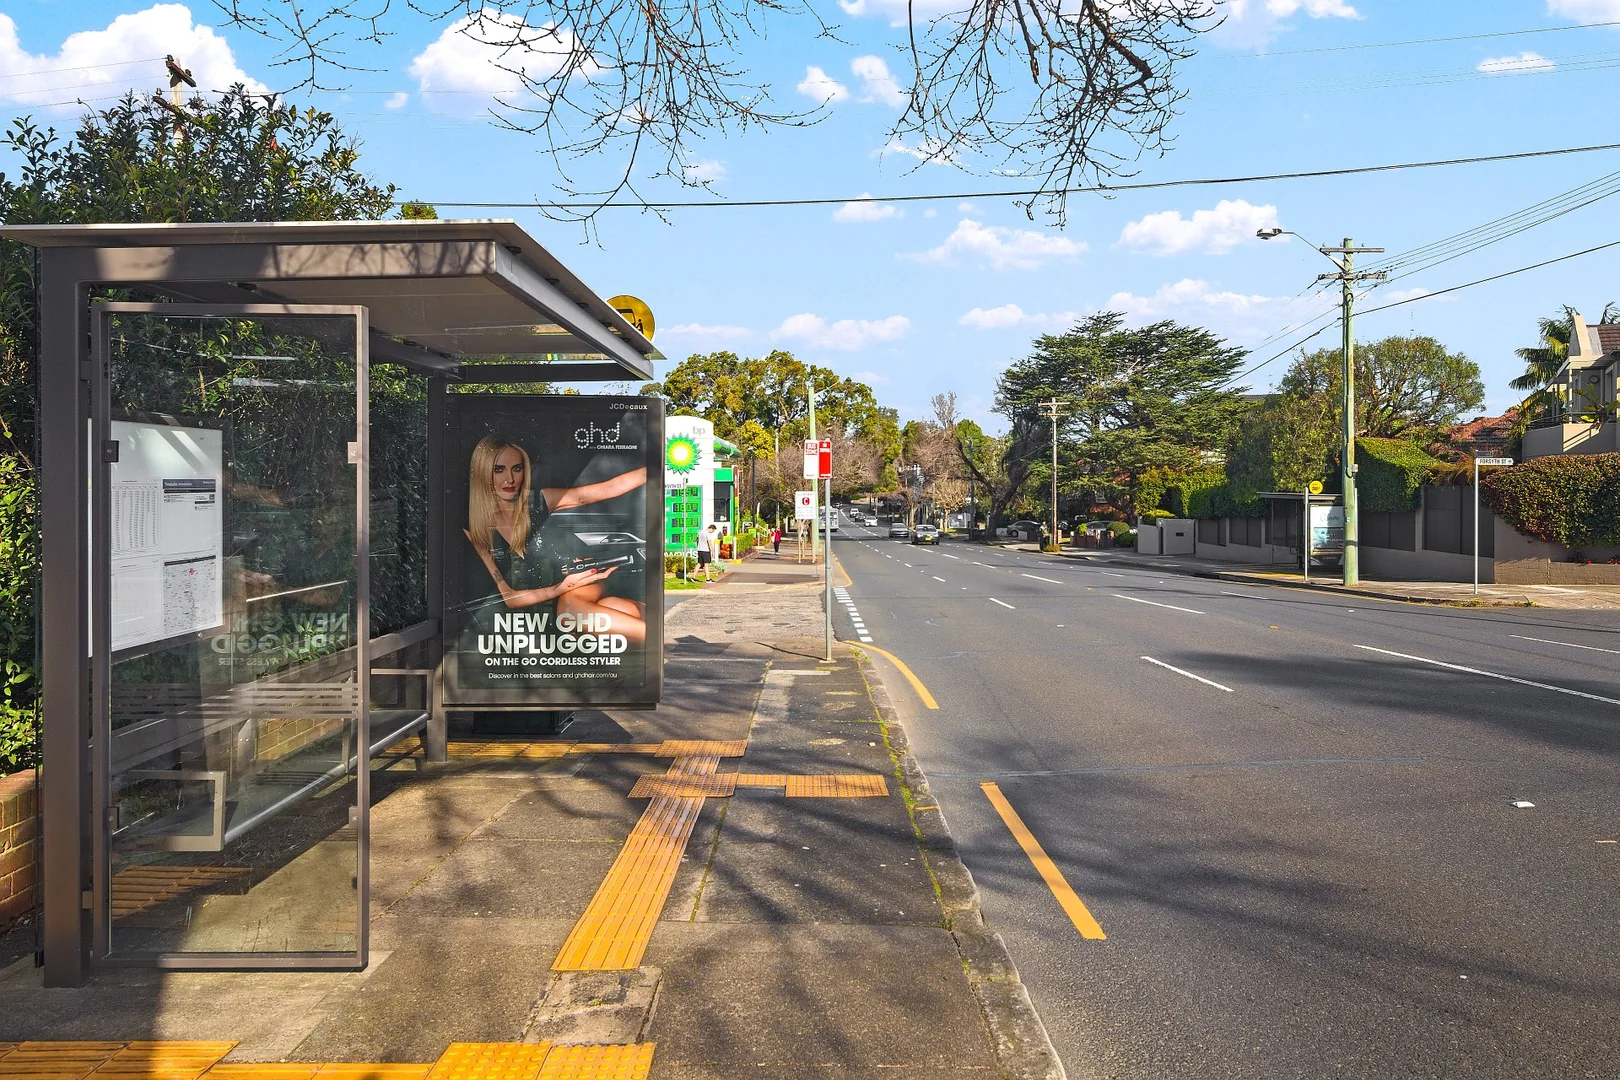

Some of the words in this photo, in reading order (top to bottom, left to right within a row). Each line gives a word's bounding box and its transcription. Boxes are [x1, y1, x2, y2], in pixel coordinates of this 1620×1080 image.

[574, 421, 620, 449] ghd
[692, 426, 706, 436] bp
[494, 612, 549, 633] NEW
[555, 612, 612, 633] GHD
[477, 634, 628, 655] UNPLUGGED
[484, 657, 501, 666] ON
[502, 657, 519, 666] THE
[521, 657, 538, 666] GO
[539, 657, 588, 666] CORDLESS
[589, 657, 621, 666] STYLER
[574, 672, 618, 680] ghdhair.com/au
